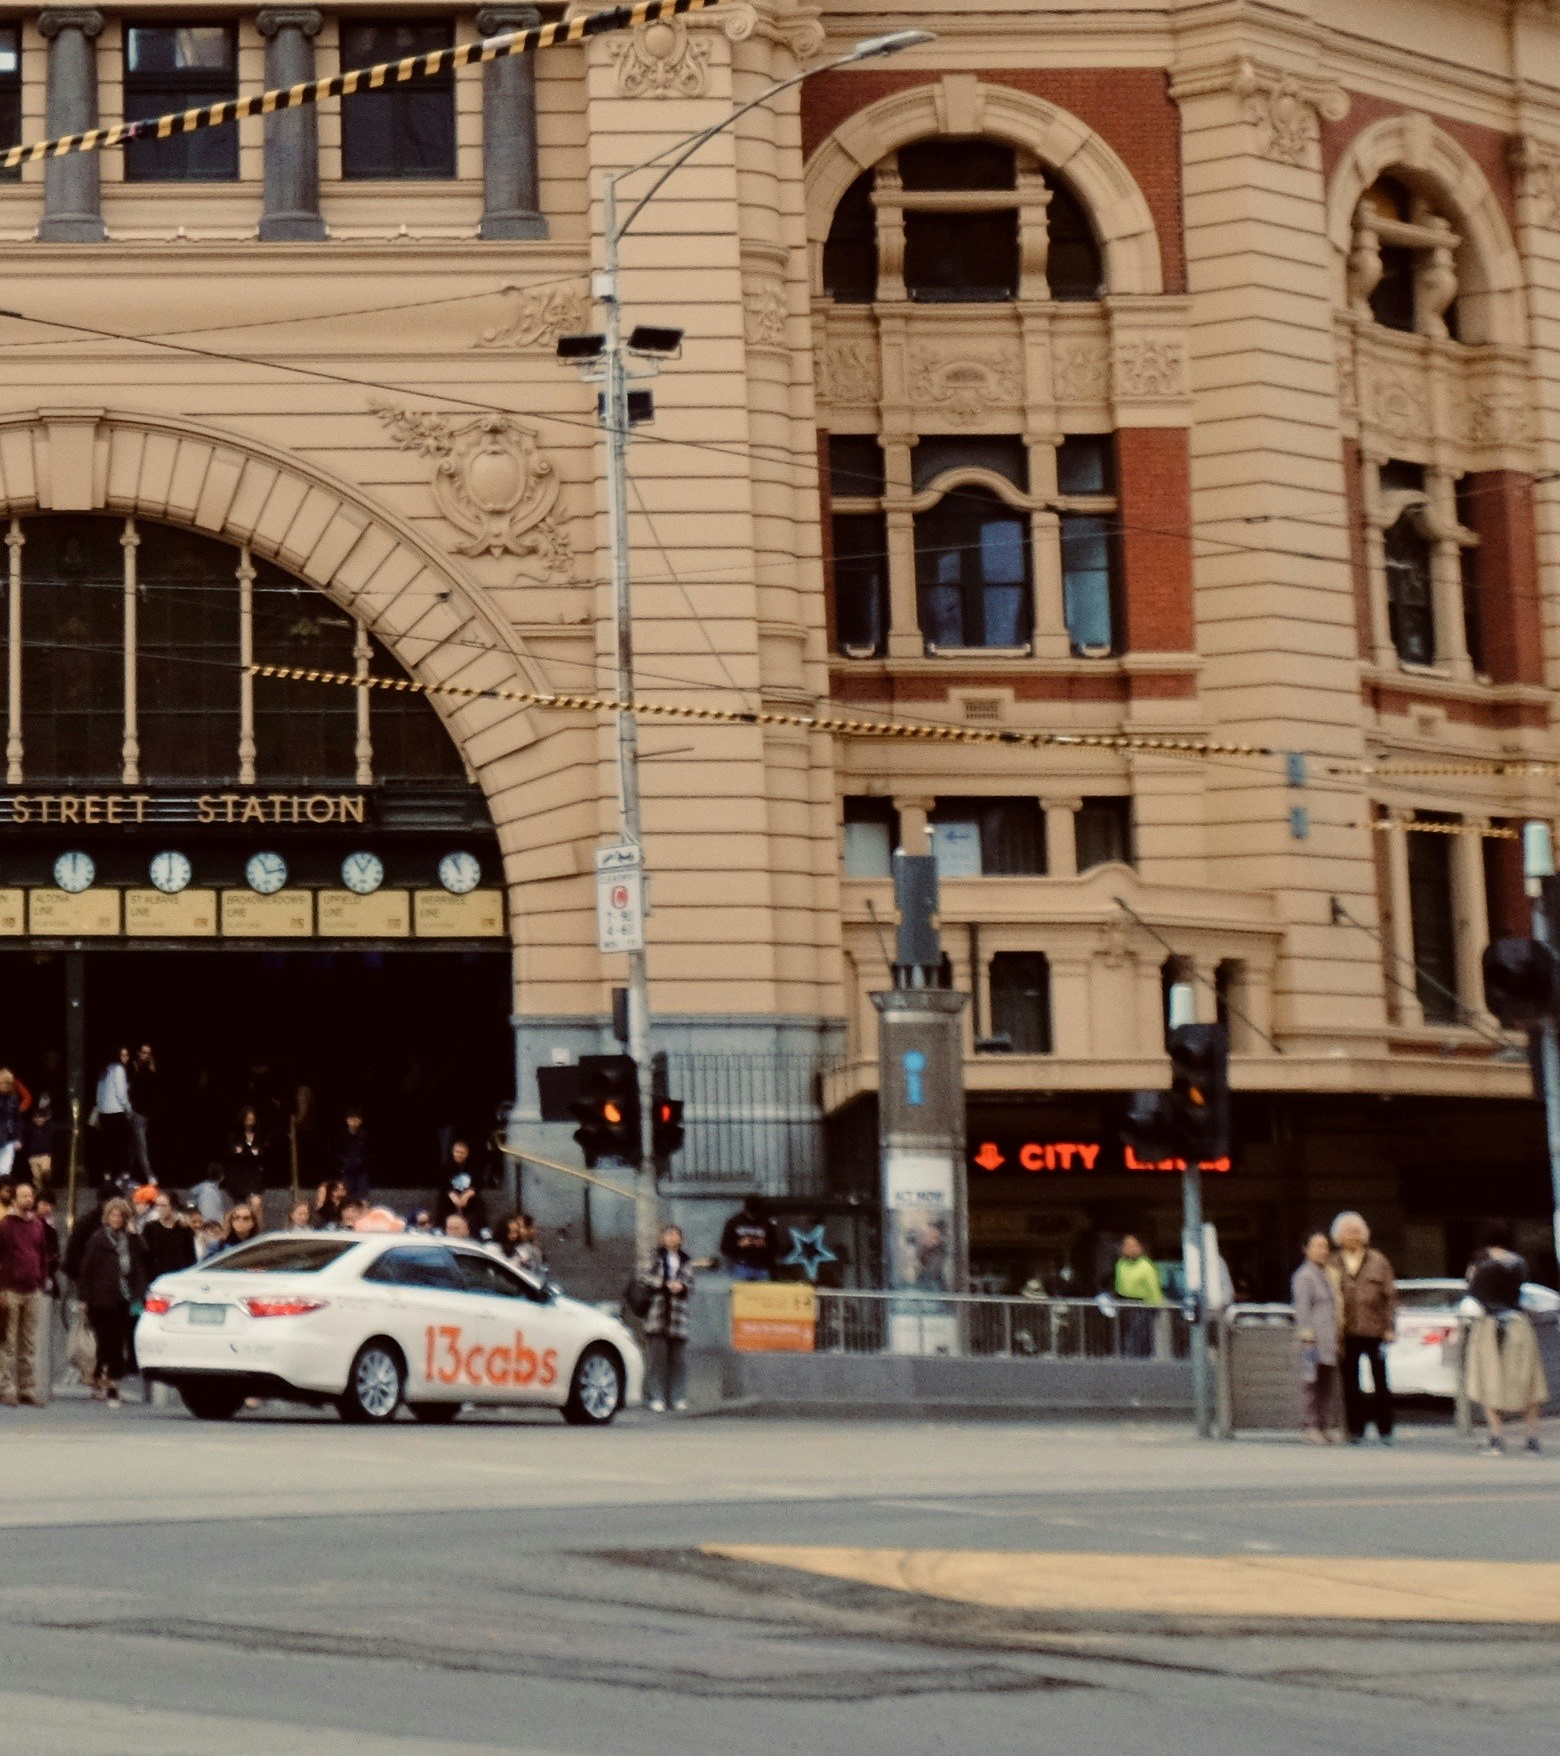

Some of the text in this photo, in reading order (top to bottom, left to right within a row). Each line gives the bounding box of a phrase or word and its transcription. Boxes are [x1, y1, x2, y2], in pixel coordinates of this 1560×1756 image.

[12, 795, 149, 824] STREET
[197, 795, 365, 823] STATION
[1019, 1143, 1100, 1171] CITY
[426, 1325, 560, 1387] 13cabs
